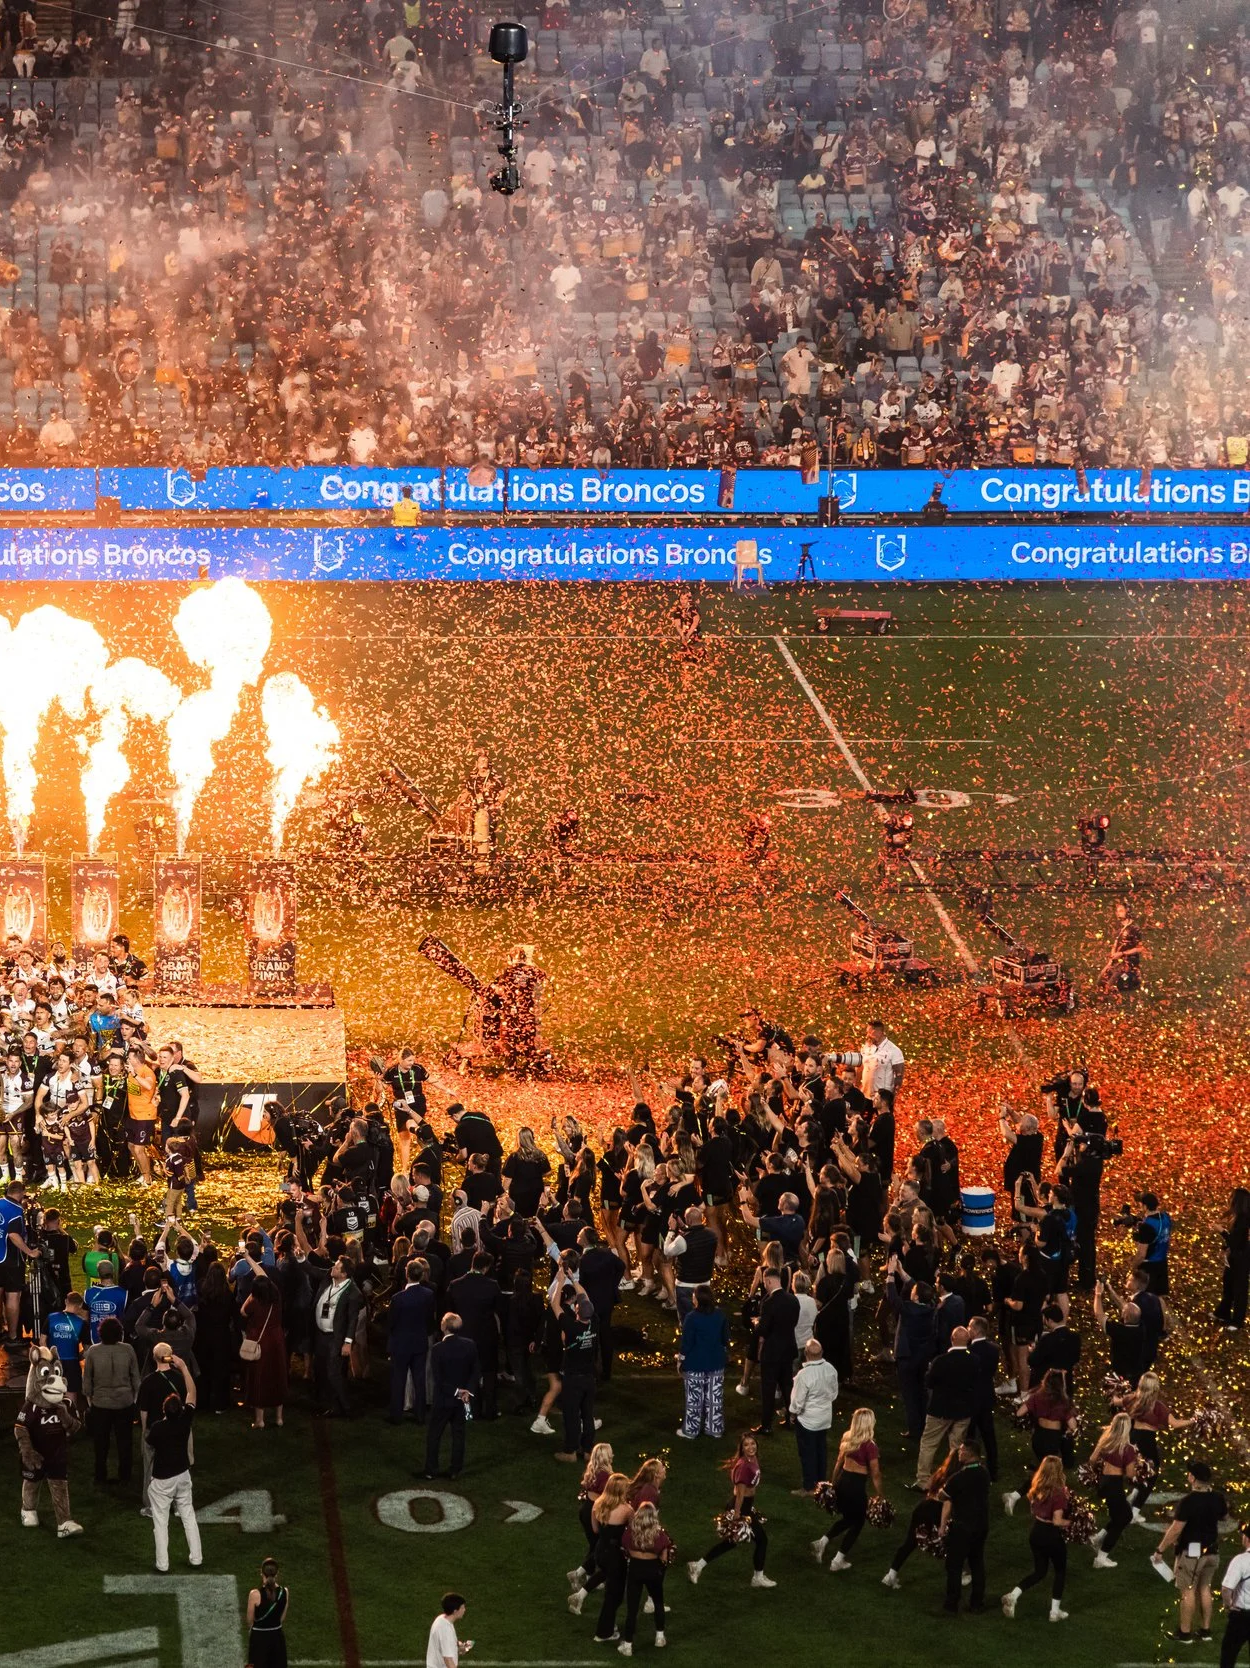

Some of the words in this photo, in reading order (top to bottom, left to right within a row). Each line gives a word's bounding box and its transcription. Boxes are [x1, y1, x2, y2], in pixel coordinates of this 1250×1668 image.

[581, 478, 705, 504] Broncos
[980, 477, 1226, 509] Congratulations
[104, 542, 212, 566] Broncos
[447, 542, 659, 569] Congratulations
[665, 543, 772, 566] Broncs
[1011, 542, 1225, 569] Congratulations
